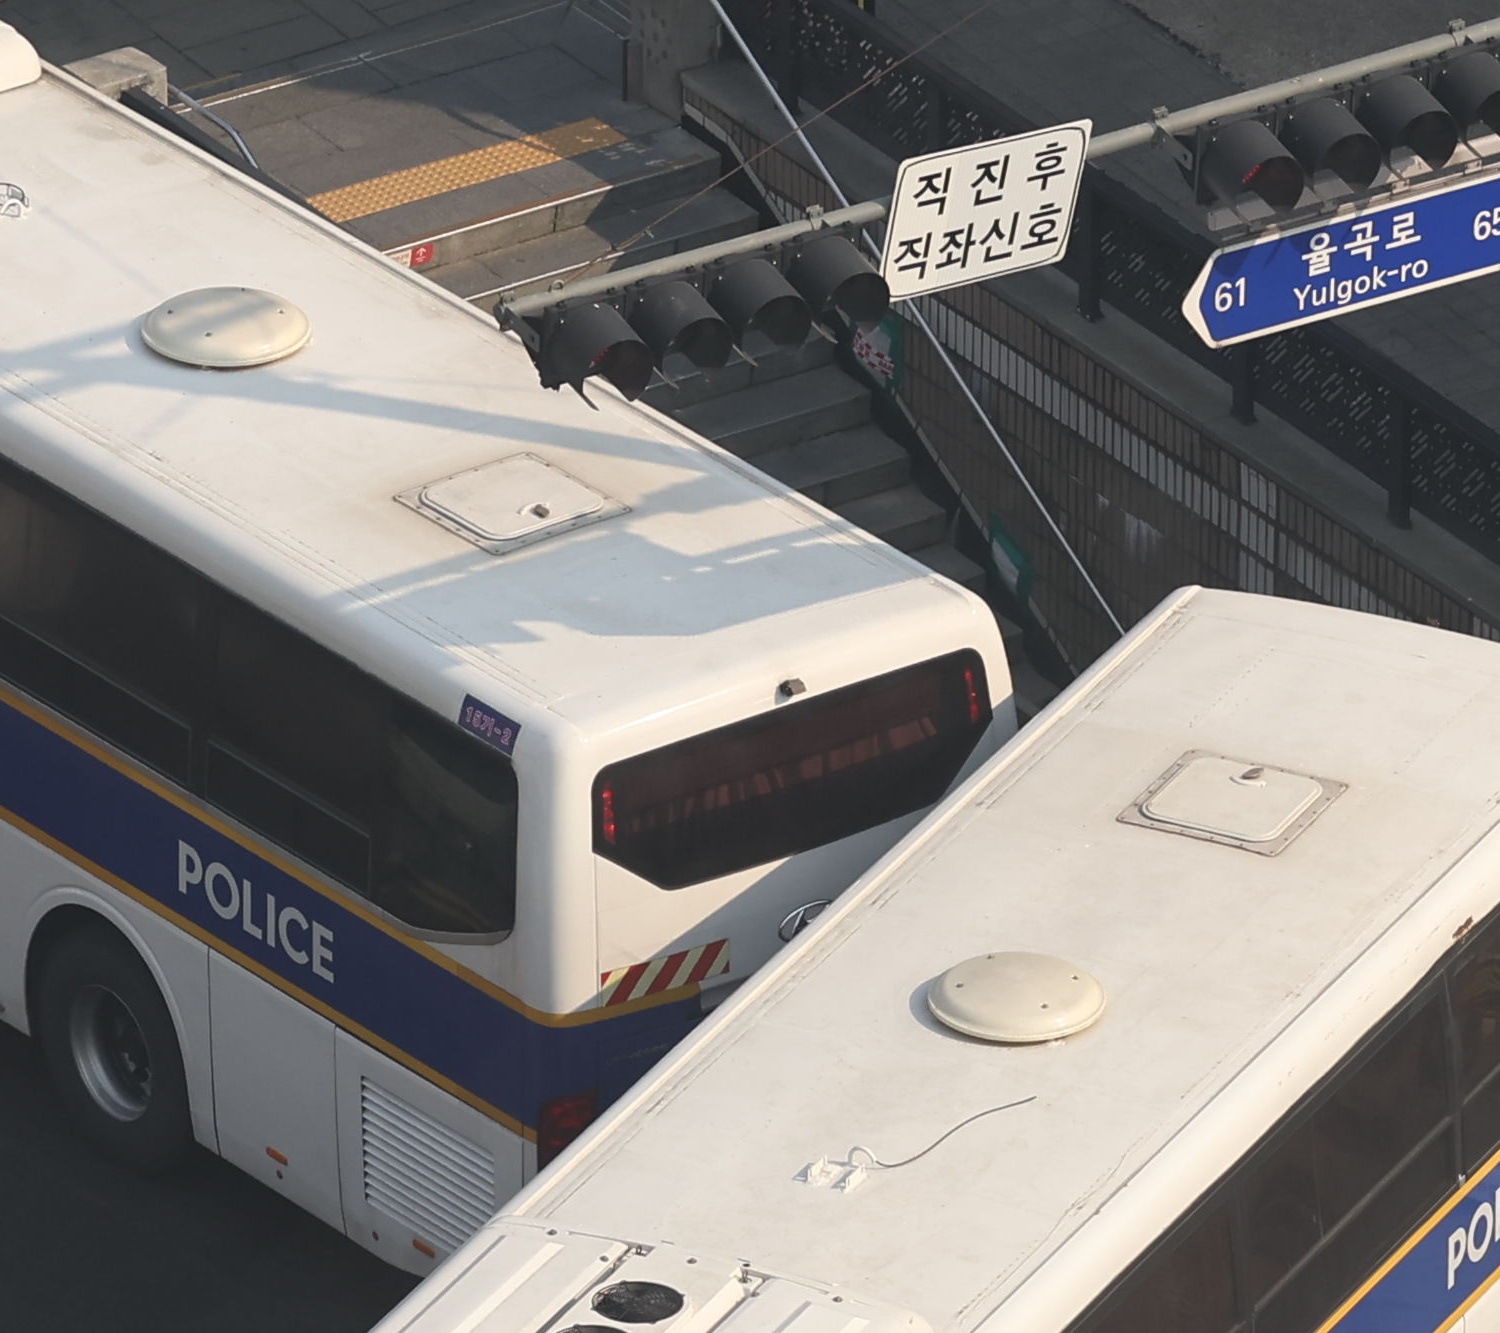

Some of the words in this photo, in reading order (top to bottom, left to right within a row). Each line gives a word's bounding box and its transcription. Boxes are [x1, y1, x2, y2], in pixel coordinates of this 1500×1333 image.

[892, 202, 1060, 280] 직좌신호
[1300, 211, 1422, 277] 율곡로
[1213, 277, 1250, 313] 61
[1292, 256, 1429, 312] Yulgok-ro
[179, 839, 335, 985] POLICE
